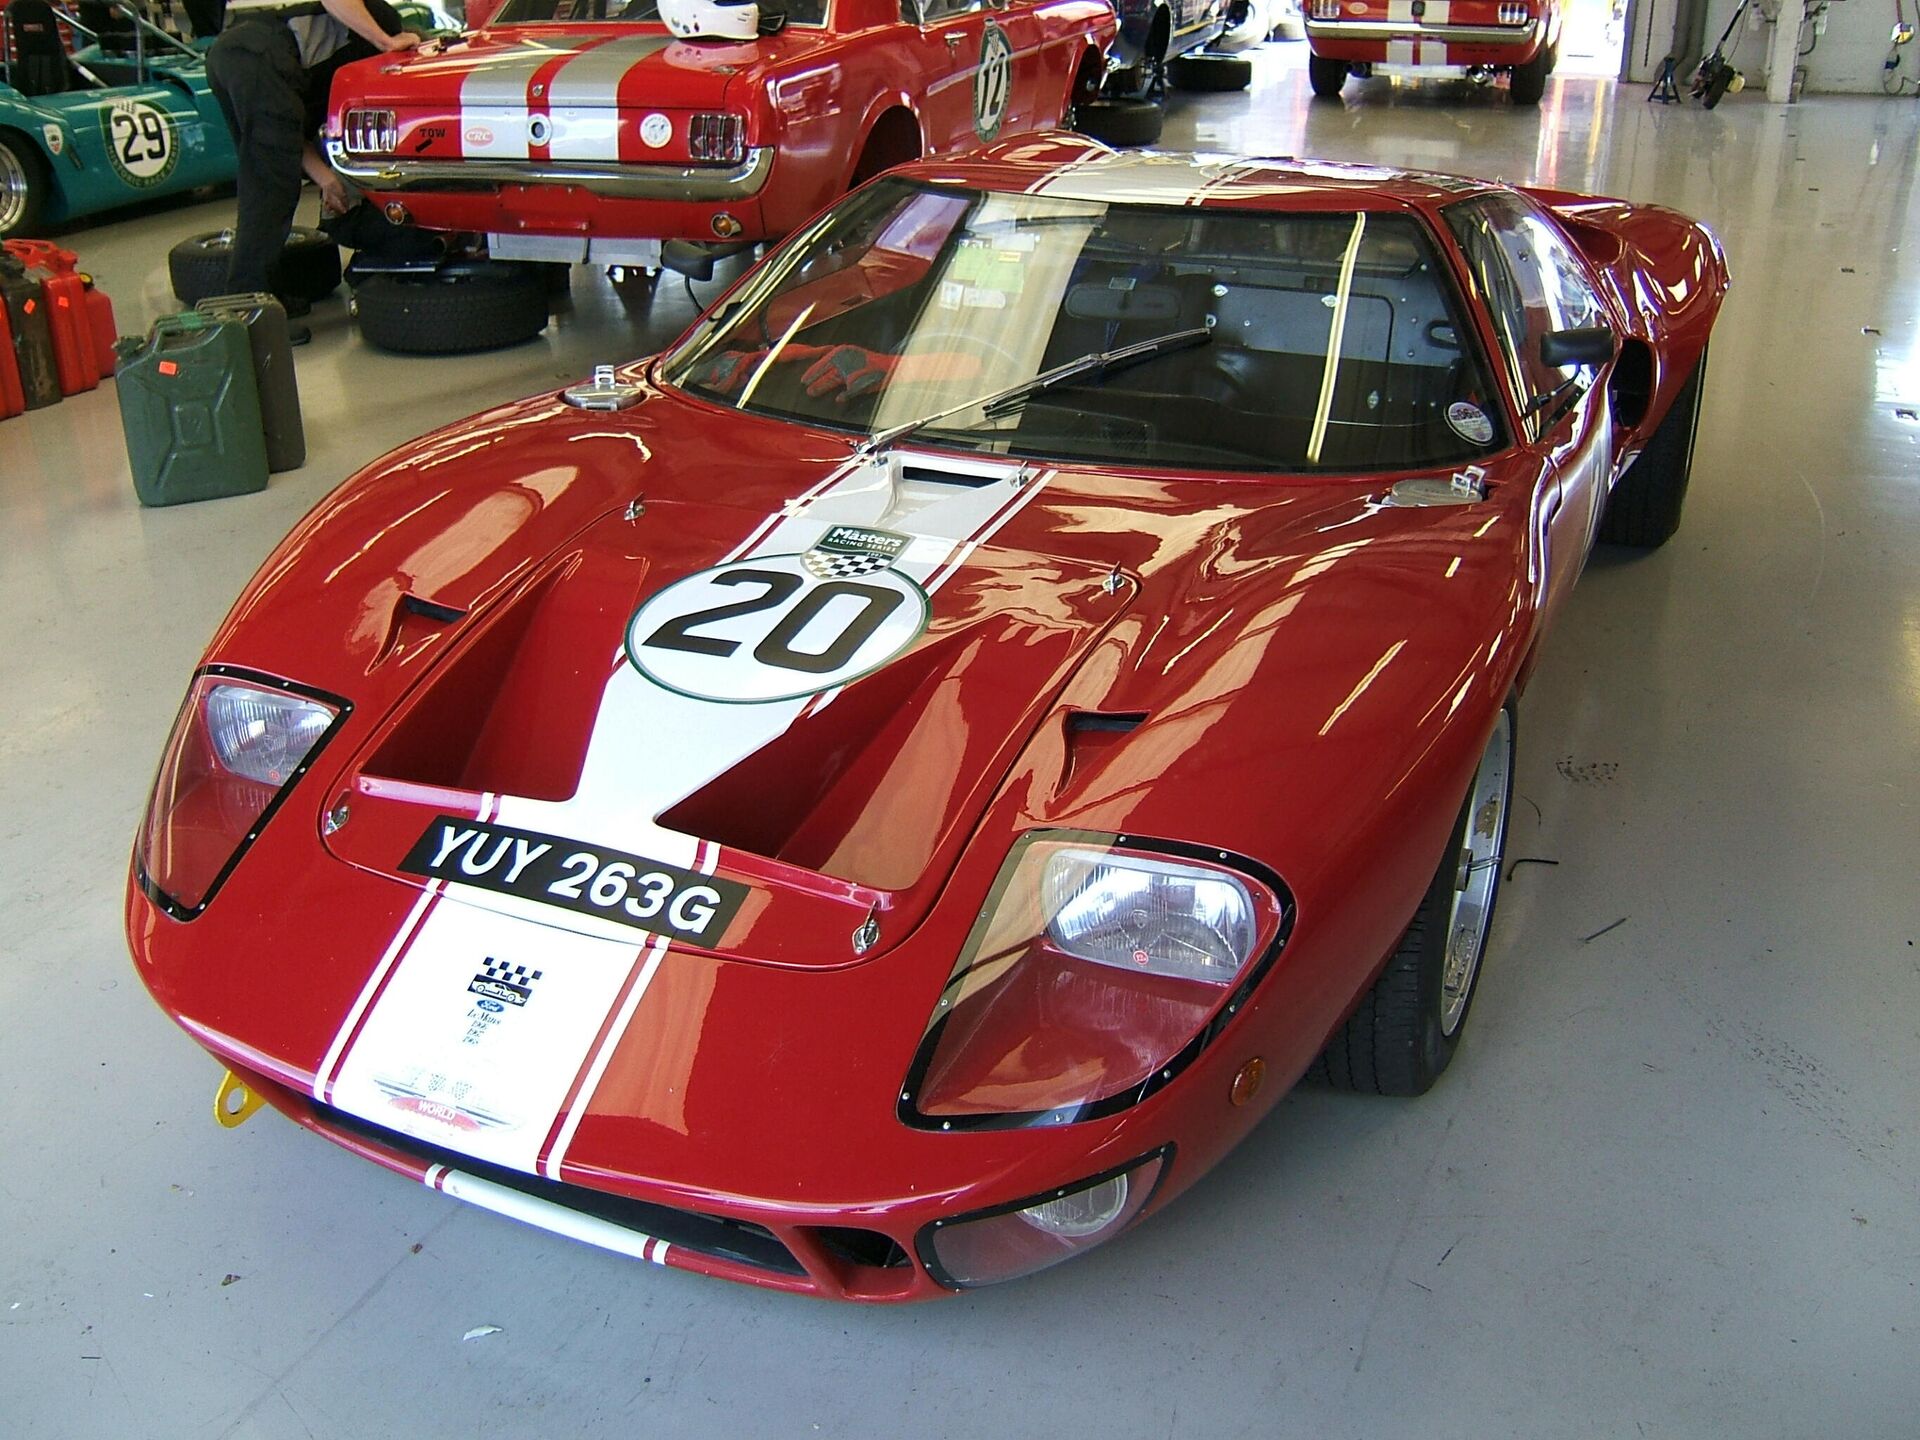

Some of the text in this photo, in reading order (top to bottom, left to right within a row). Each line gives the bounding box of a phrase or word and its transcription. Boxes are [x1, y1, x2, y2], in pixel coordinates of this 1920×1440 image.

[980, 52, 1006, 119] 12
[113, 112, 166, 164] 29
[420, 128, 446, 138] TOW
[828, 537, 897, 553] RACING SERIES
[832, 528, 903, 547] Masters
[641, 569, 905, 674] 20
[430, 826, 721, 934] YUY 263G
[418, 1100, 456, 1120] WORLD
